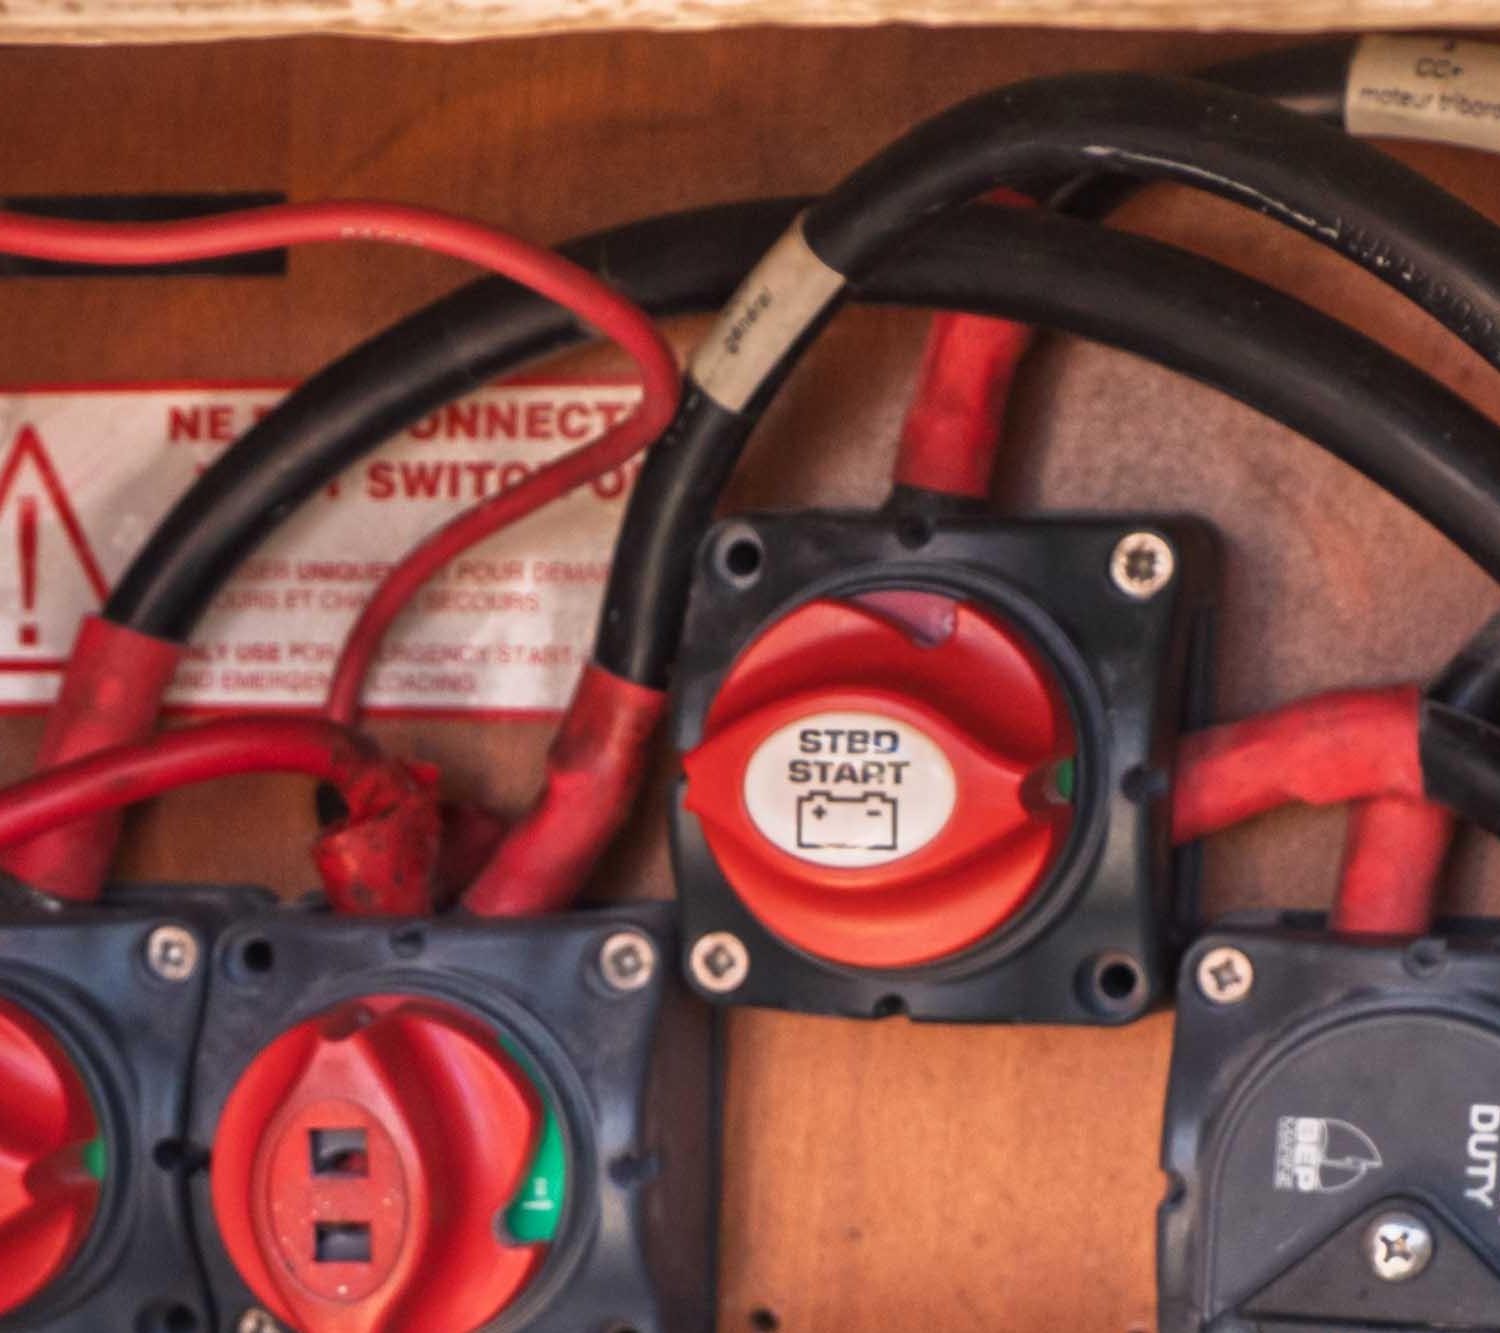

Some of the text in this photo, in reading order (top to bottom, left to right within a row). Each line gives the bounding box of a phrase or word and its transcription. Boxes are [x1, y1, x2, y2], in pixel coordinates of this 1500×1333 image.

[406, 400, 634, 441] ONNECT
[364, 460, 546, 501] SWITC
[799, 728, 900, 754] STBD
[788, 759, 910, 785] START
